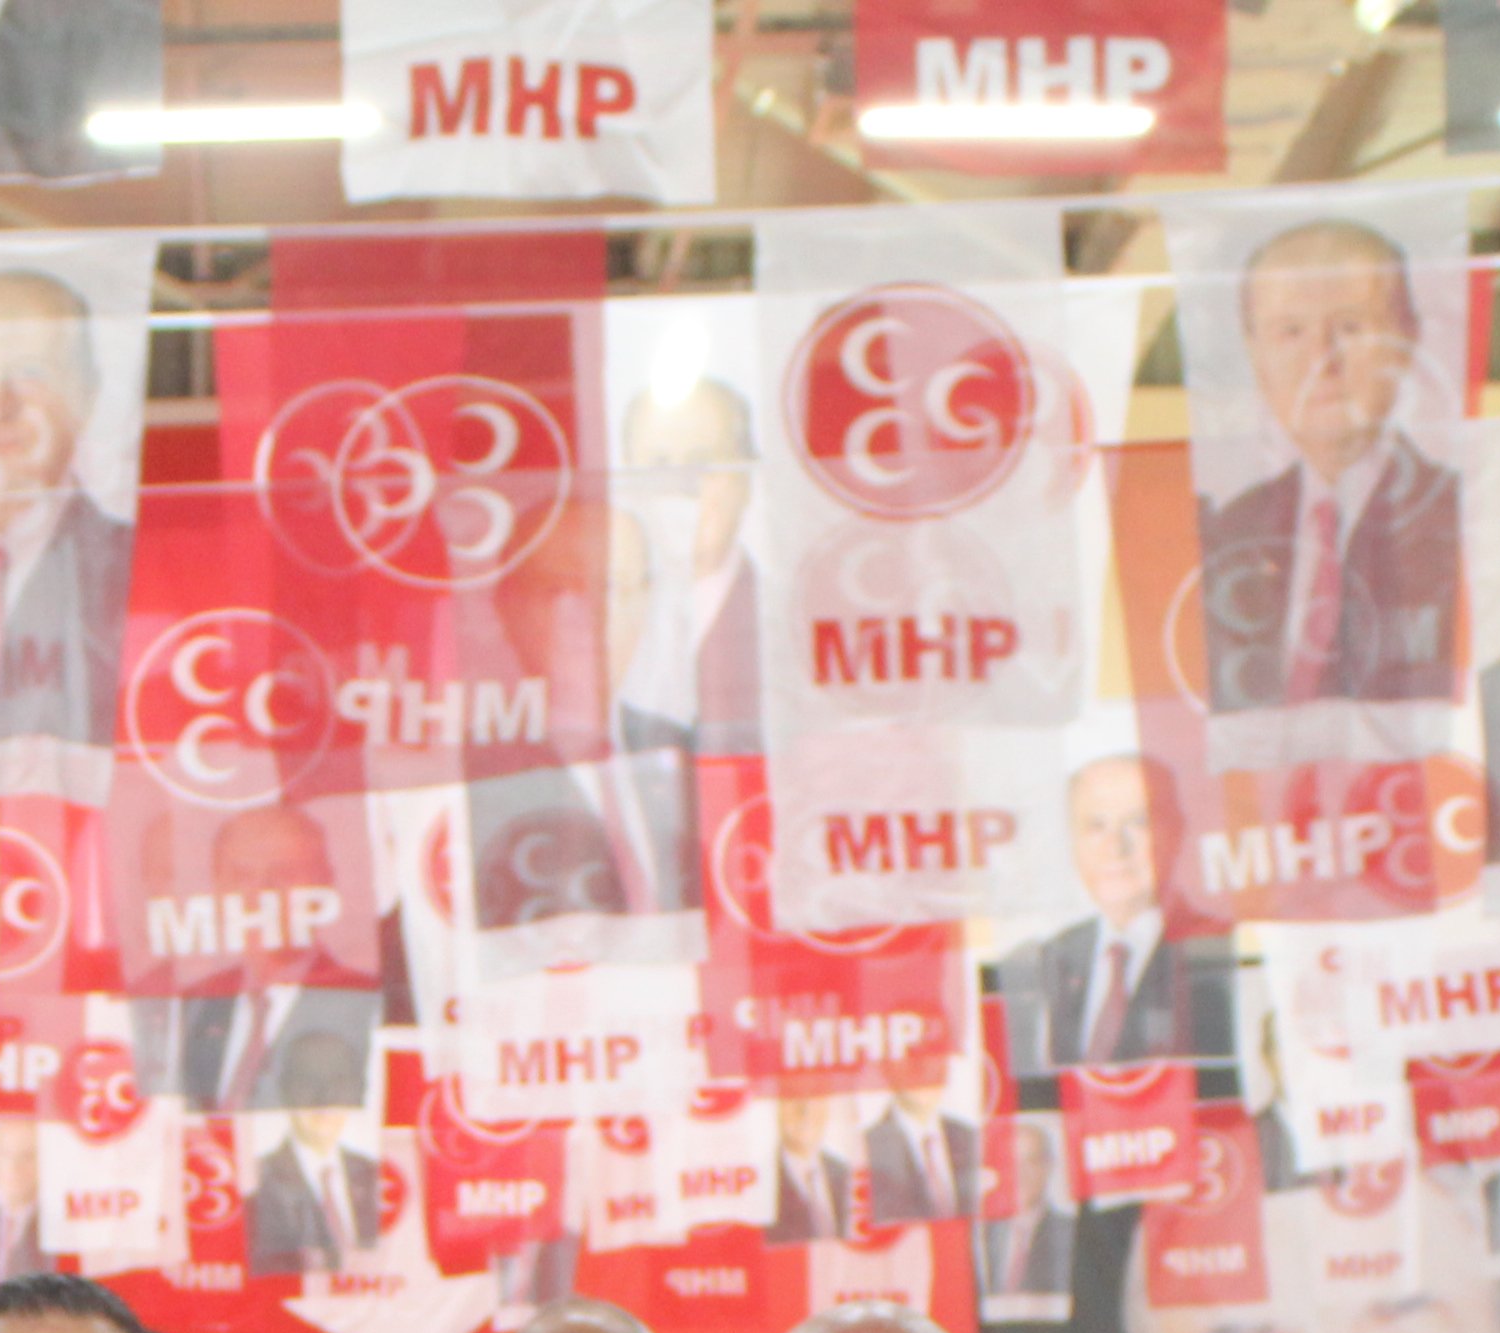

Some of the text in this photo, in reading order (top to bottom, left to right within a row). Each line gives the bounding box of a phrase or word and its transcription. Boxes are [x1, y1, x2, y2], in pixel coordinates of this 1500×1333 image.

[408, 56, 636, 143] MHP
[916, 35, 1171, 108] MHP
[812, 615, 1017, 688] MHP
[825, 811, 1017, 874] MHP
[1201, 812, 1391, 893] MHP
[147, 886, 342, 957] MHP
[499, 1037, 641, 1086] MHP
[782, 1012, 925, 1069] MHP
[1082, 1126, 1176, 1172] MHP
[66, 1191, 139, 1221] MHP
[457, 1182, 546, 1216] MHP
[680, 1167, 757, 1198] MHP
[1326, 1250, 1403, 1281] MHP
